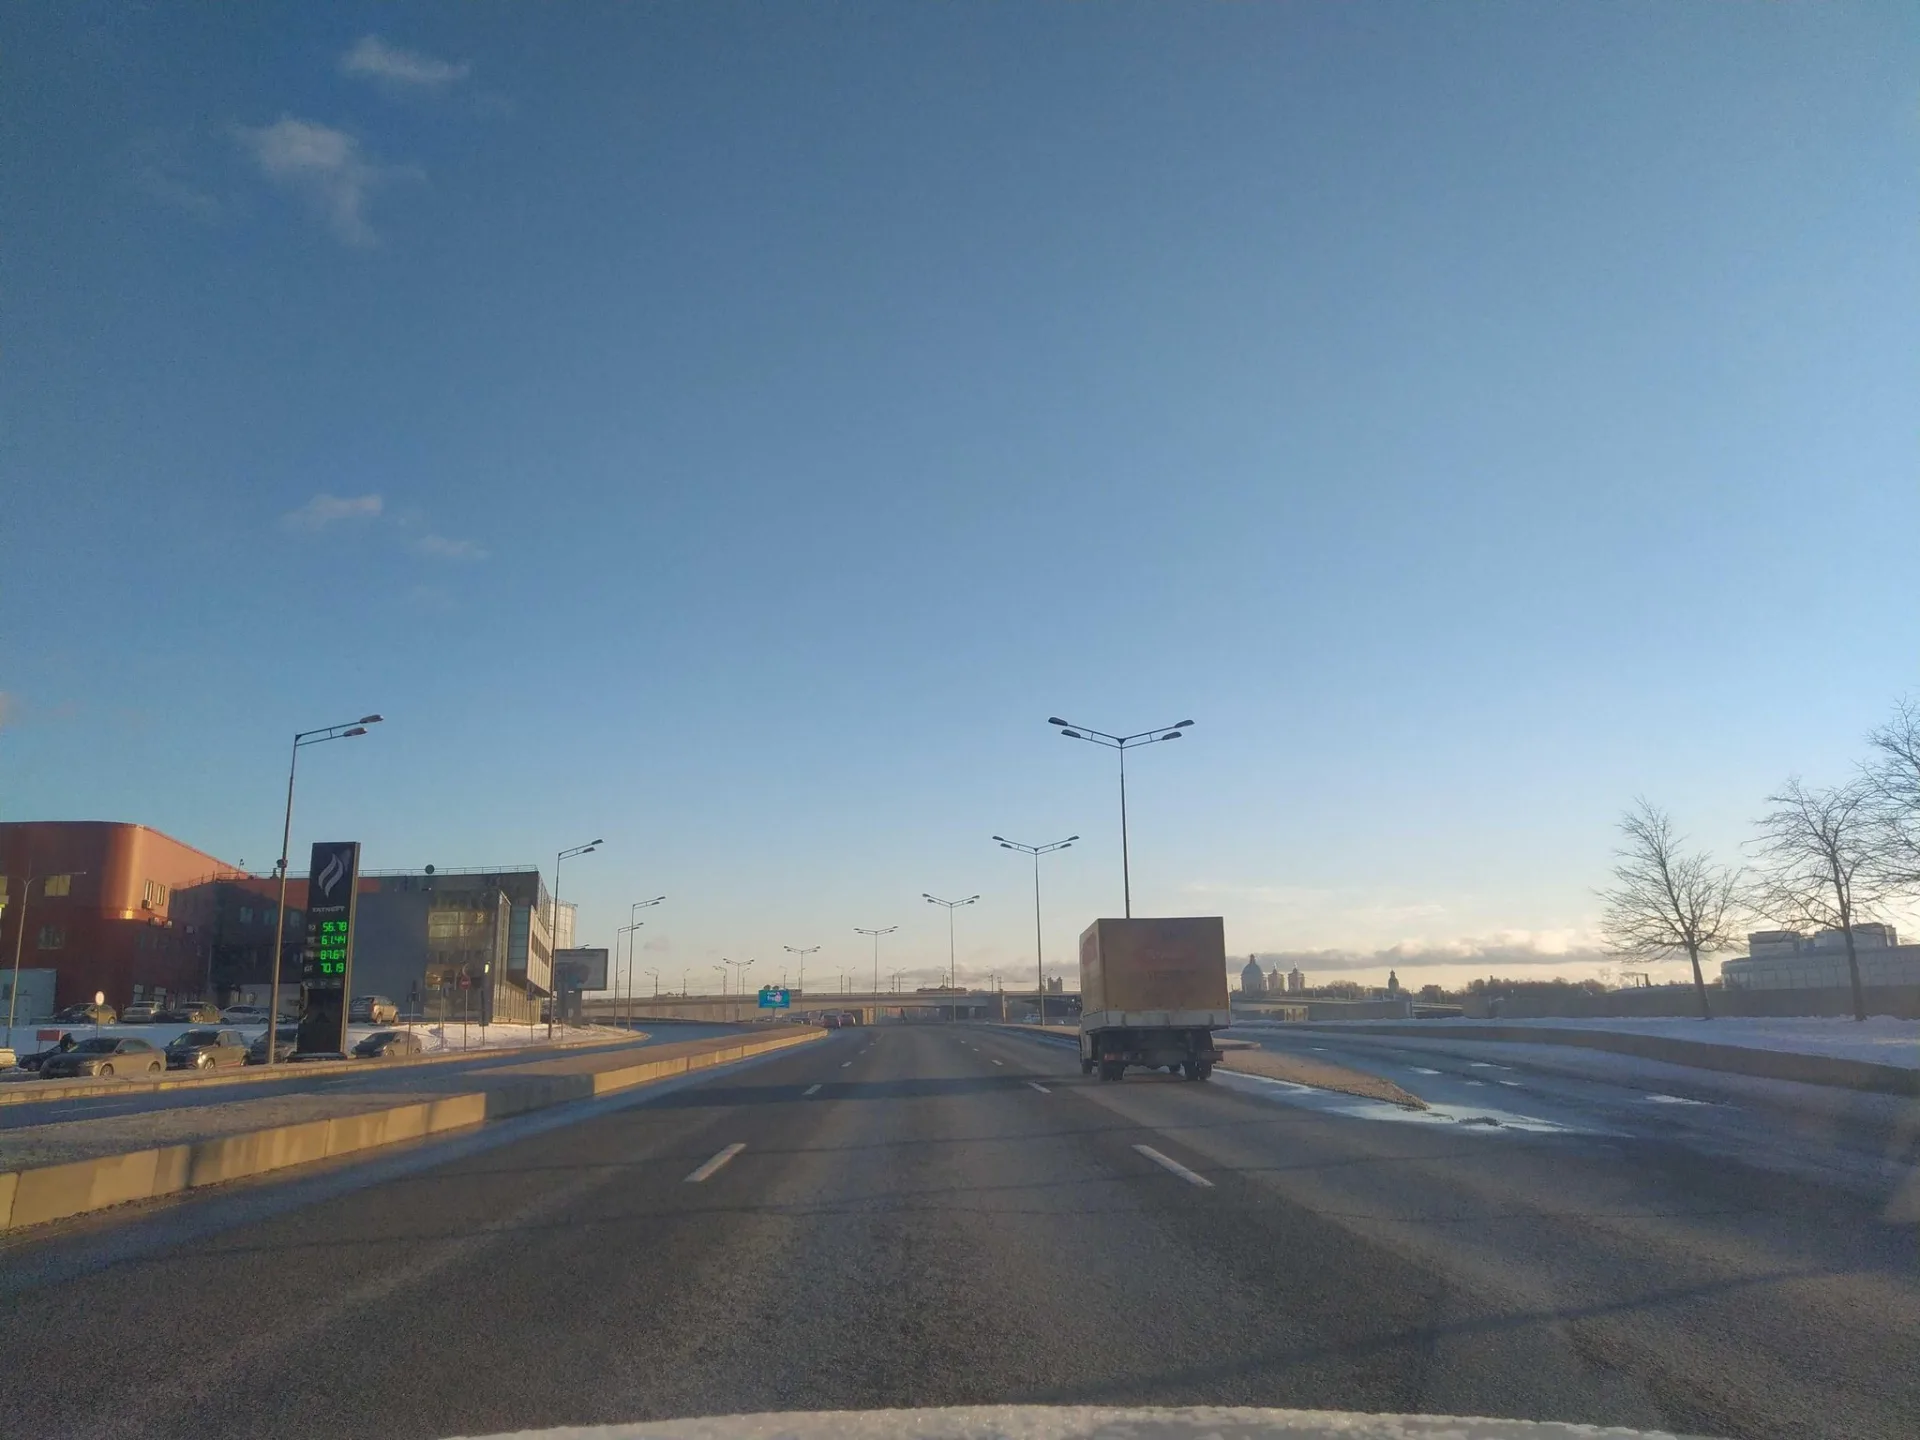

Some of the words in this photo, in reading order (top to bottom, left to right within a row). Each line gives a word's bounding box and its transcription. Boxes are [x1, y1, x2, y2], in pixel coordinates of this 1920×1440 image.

[322, 921, 347, 932] 56.78
[321, 935, 346, 945] 61.44
[320, 950, 345, 960] 87.67
[320, 963, 345, 973] 70.19
